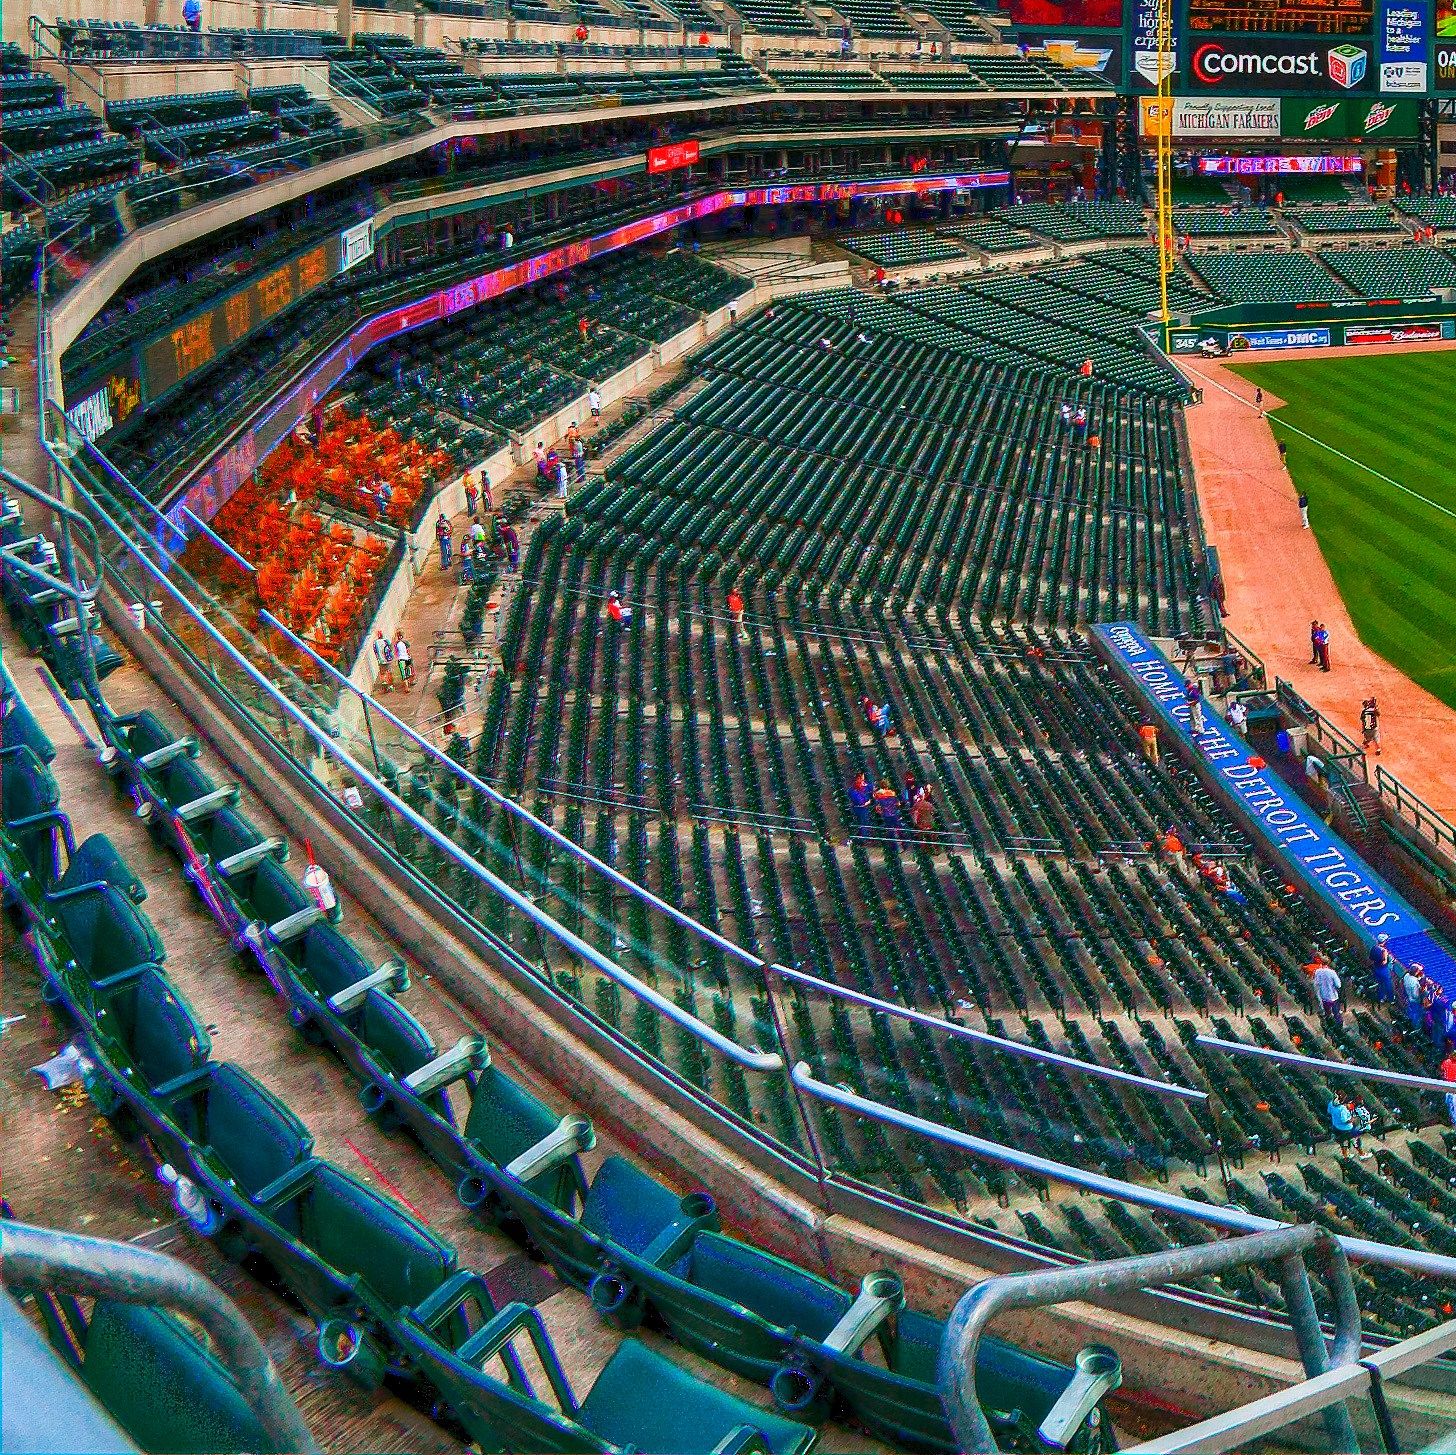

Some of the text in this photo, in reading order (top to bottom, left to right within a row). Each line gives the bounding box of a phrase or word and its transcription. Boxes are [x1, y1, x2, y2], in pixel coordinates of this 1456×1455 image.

[1178, 113, 1279, 129] MICHIGAN FARMERS
[1131, 659, 1186, 703] HOME
[1196, 725, 1240, 761] THE
[1222, 761, 1320, 848] DETROIT
[1303, 846, 1400, 930] TIGERS
